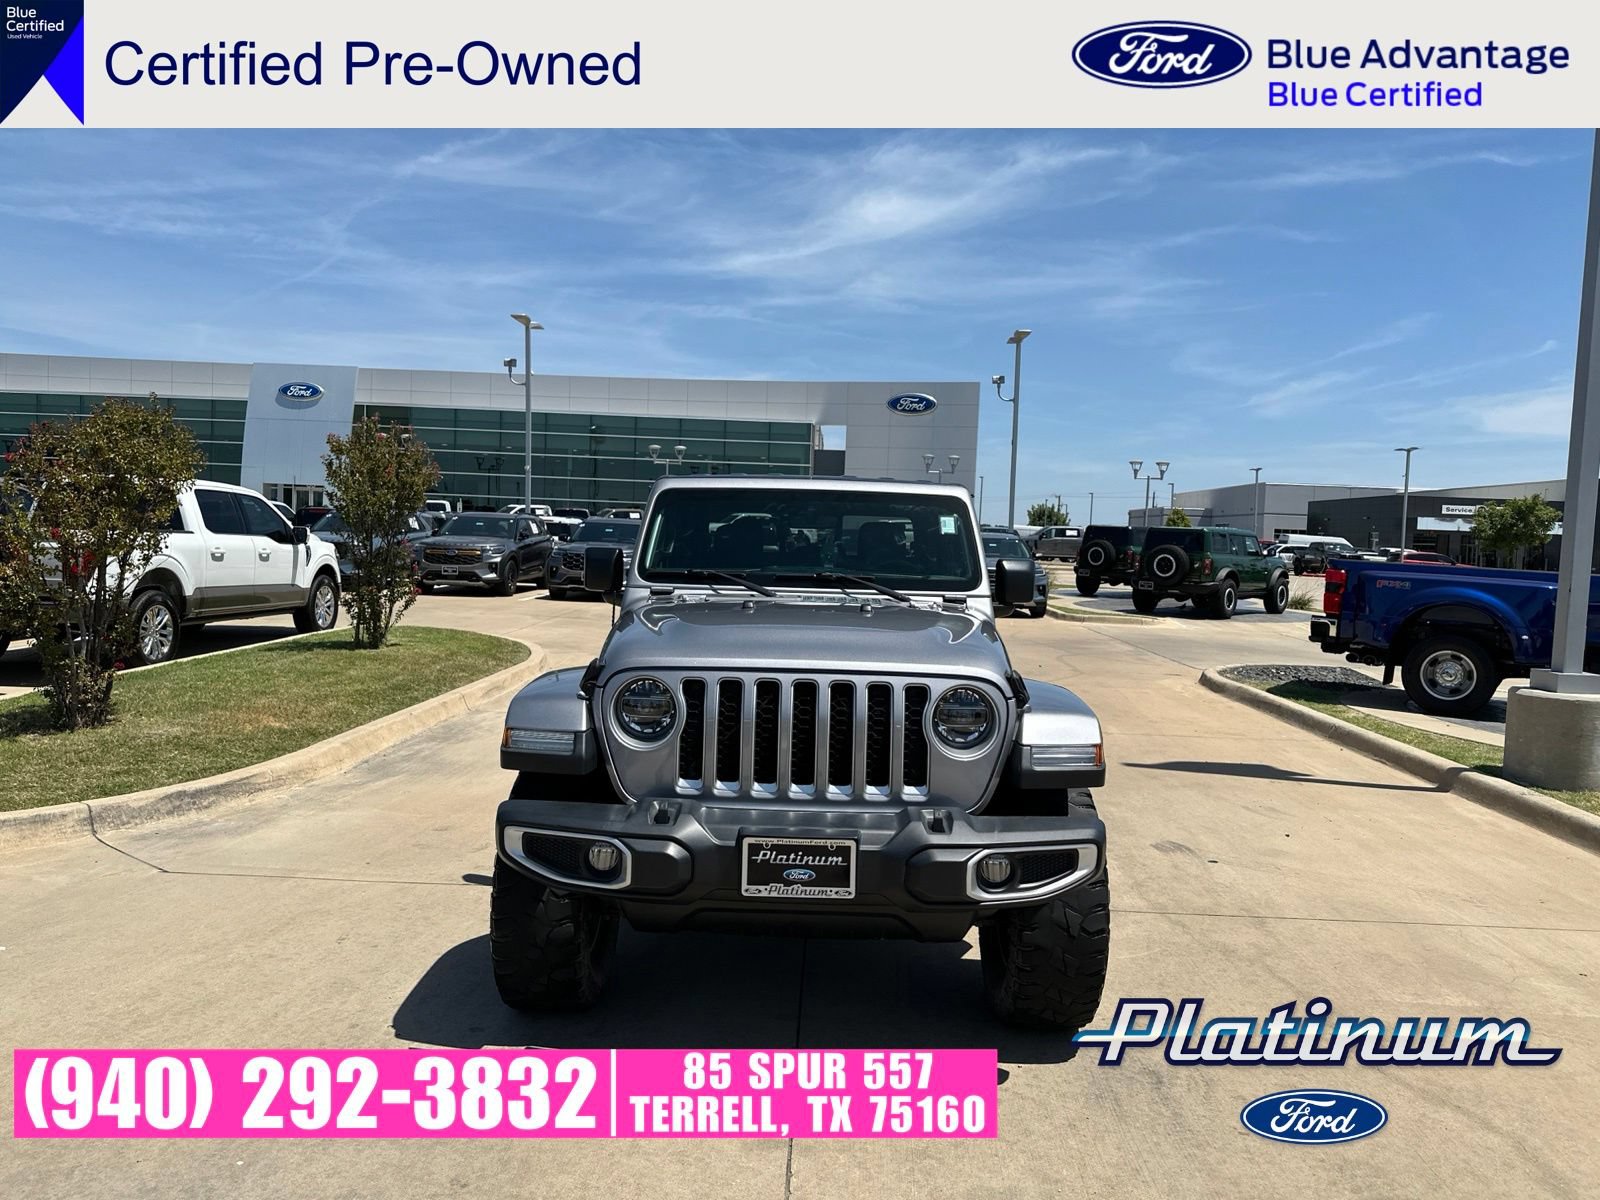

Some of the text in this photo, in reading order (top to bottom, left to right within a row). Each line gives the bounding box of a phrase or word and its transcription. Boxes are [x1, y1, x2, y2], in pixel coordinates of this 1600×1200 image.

[286, 385, 313, 397] Ford
[896, 397, 926, 411] Ford
[1446, 506, 1473, 514] Service
[752, 850, 848, 866] Platinum
[789, 871, 810, 880] Ford
[767, 884, 833, 897] Platinum
